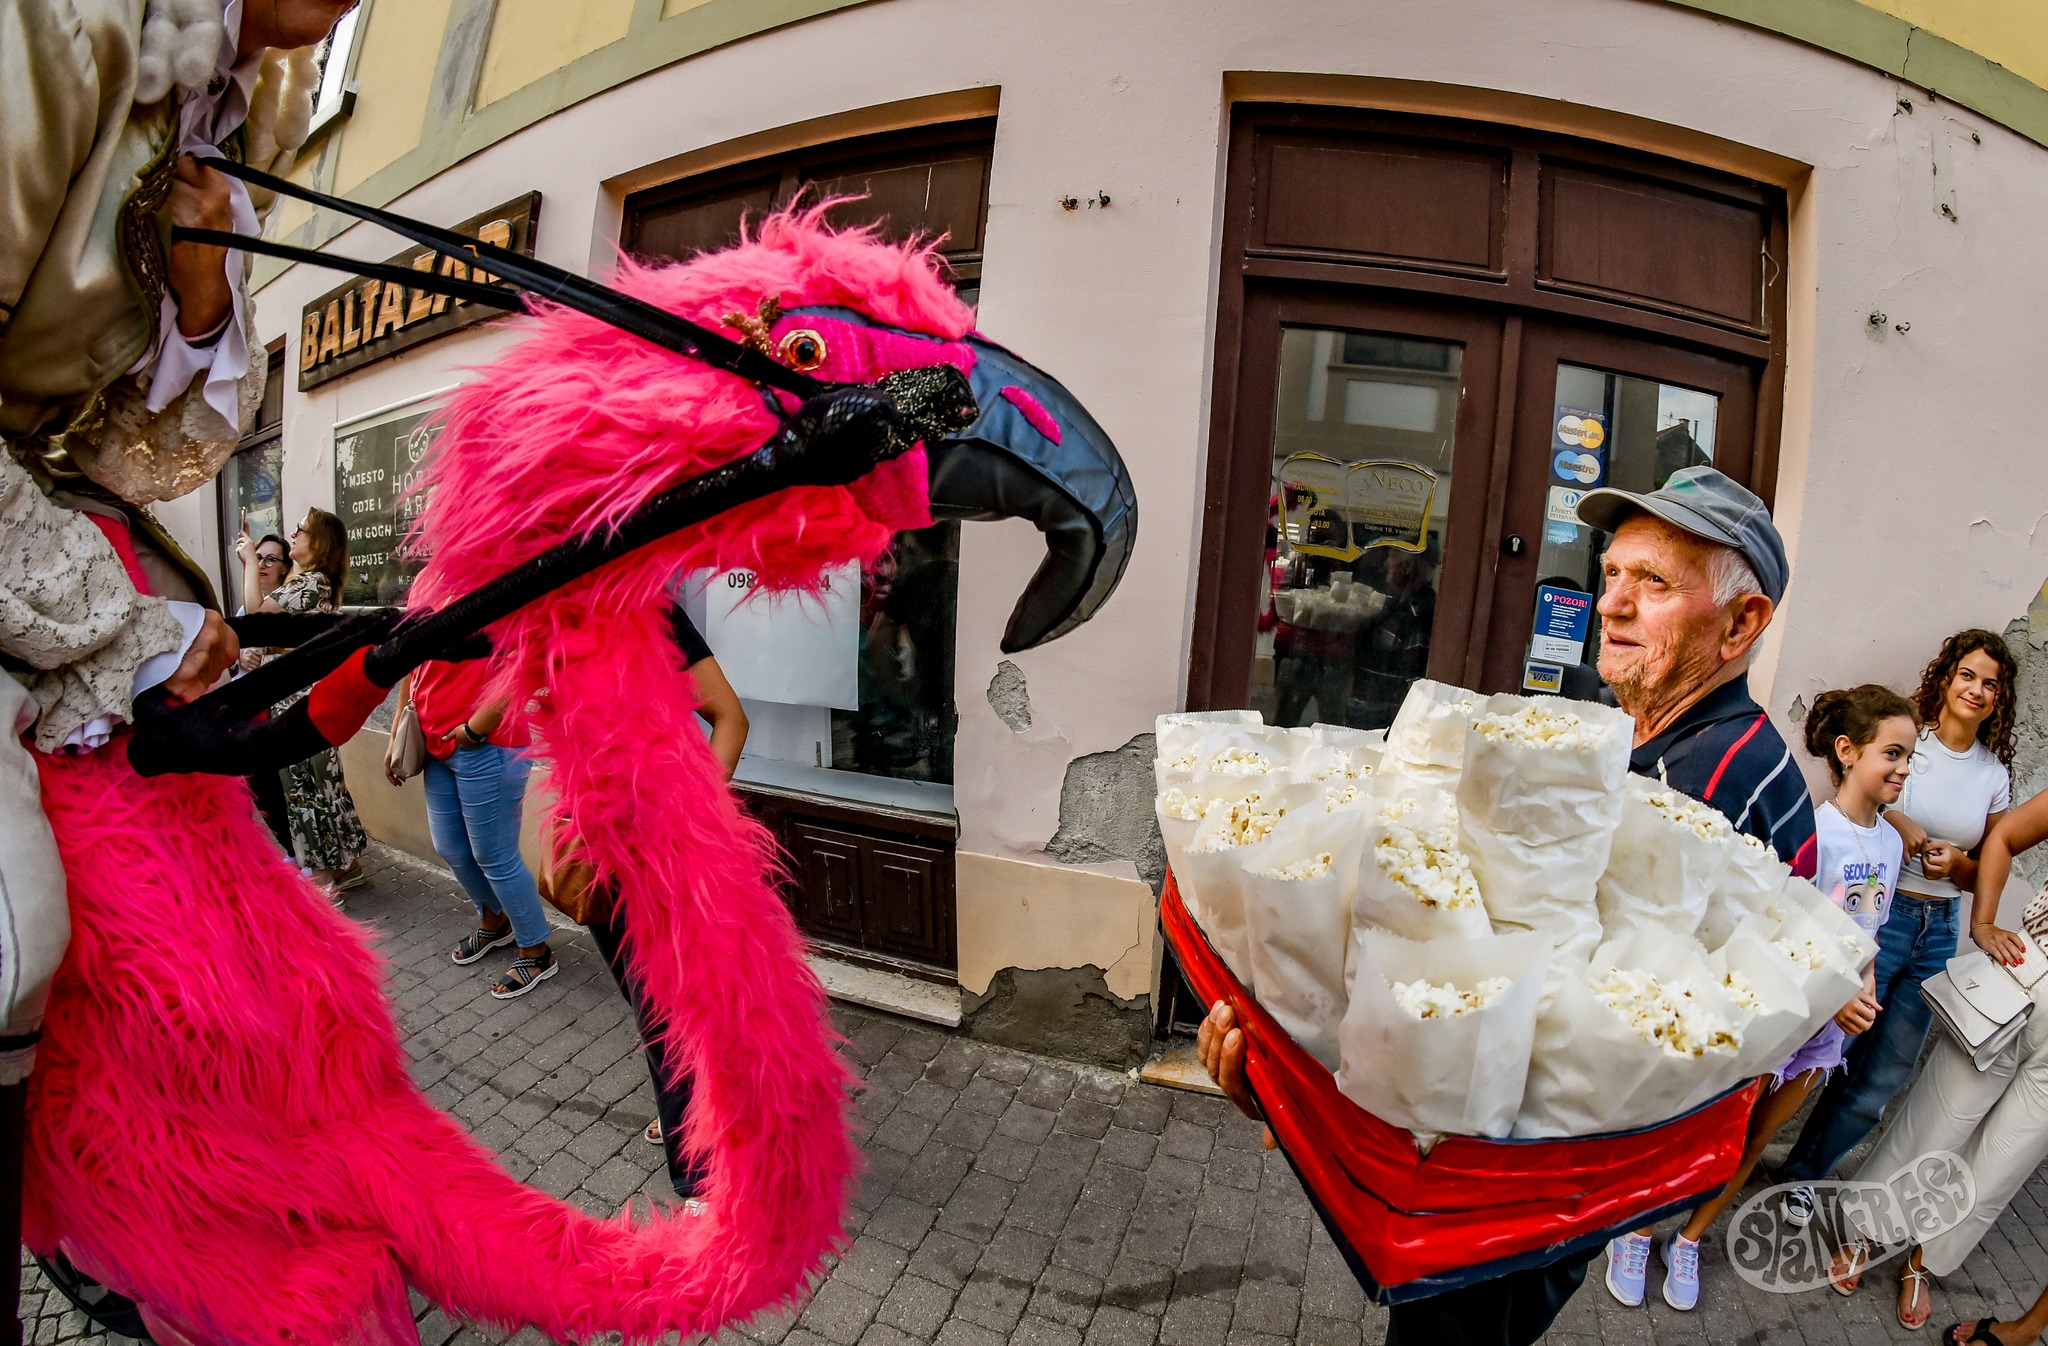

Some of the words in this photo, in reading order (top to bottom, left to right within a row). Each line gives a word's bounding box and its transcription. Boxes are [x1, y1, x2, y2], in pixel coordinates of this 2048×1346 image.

[301, 219, 514, 373] BALTAZAR
[1558, 424, 1602, 441] MasterCard
[1557, 460, 1596, 475] Maestro
[349, 468, 385, 488] MJESTO
[1371, 469, 1424, 494] NECO
[352, 498, 375, 513] GDJE
[404, 495, 423, 517] AR
[365, 524, 392, 539] GOGH
[1553, 594, 1588, 608] POZOR!
[1533, 672, 1554, 682] VISA
